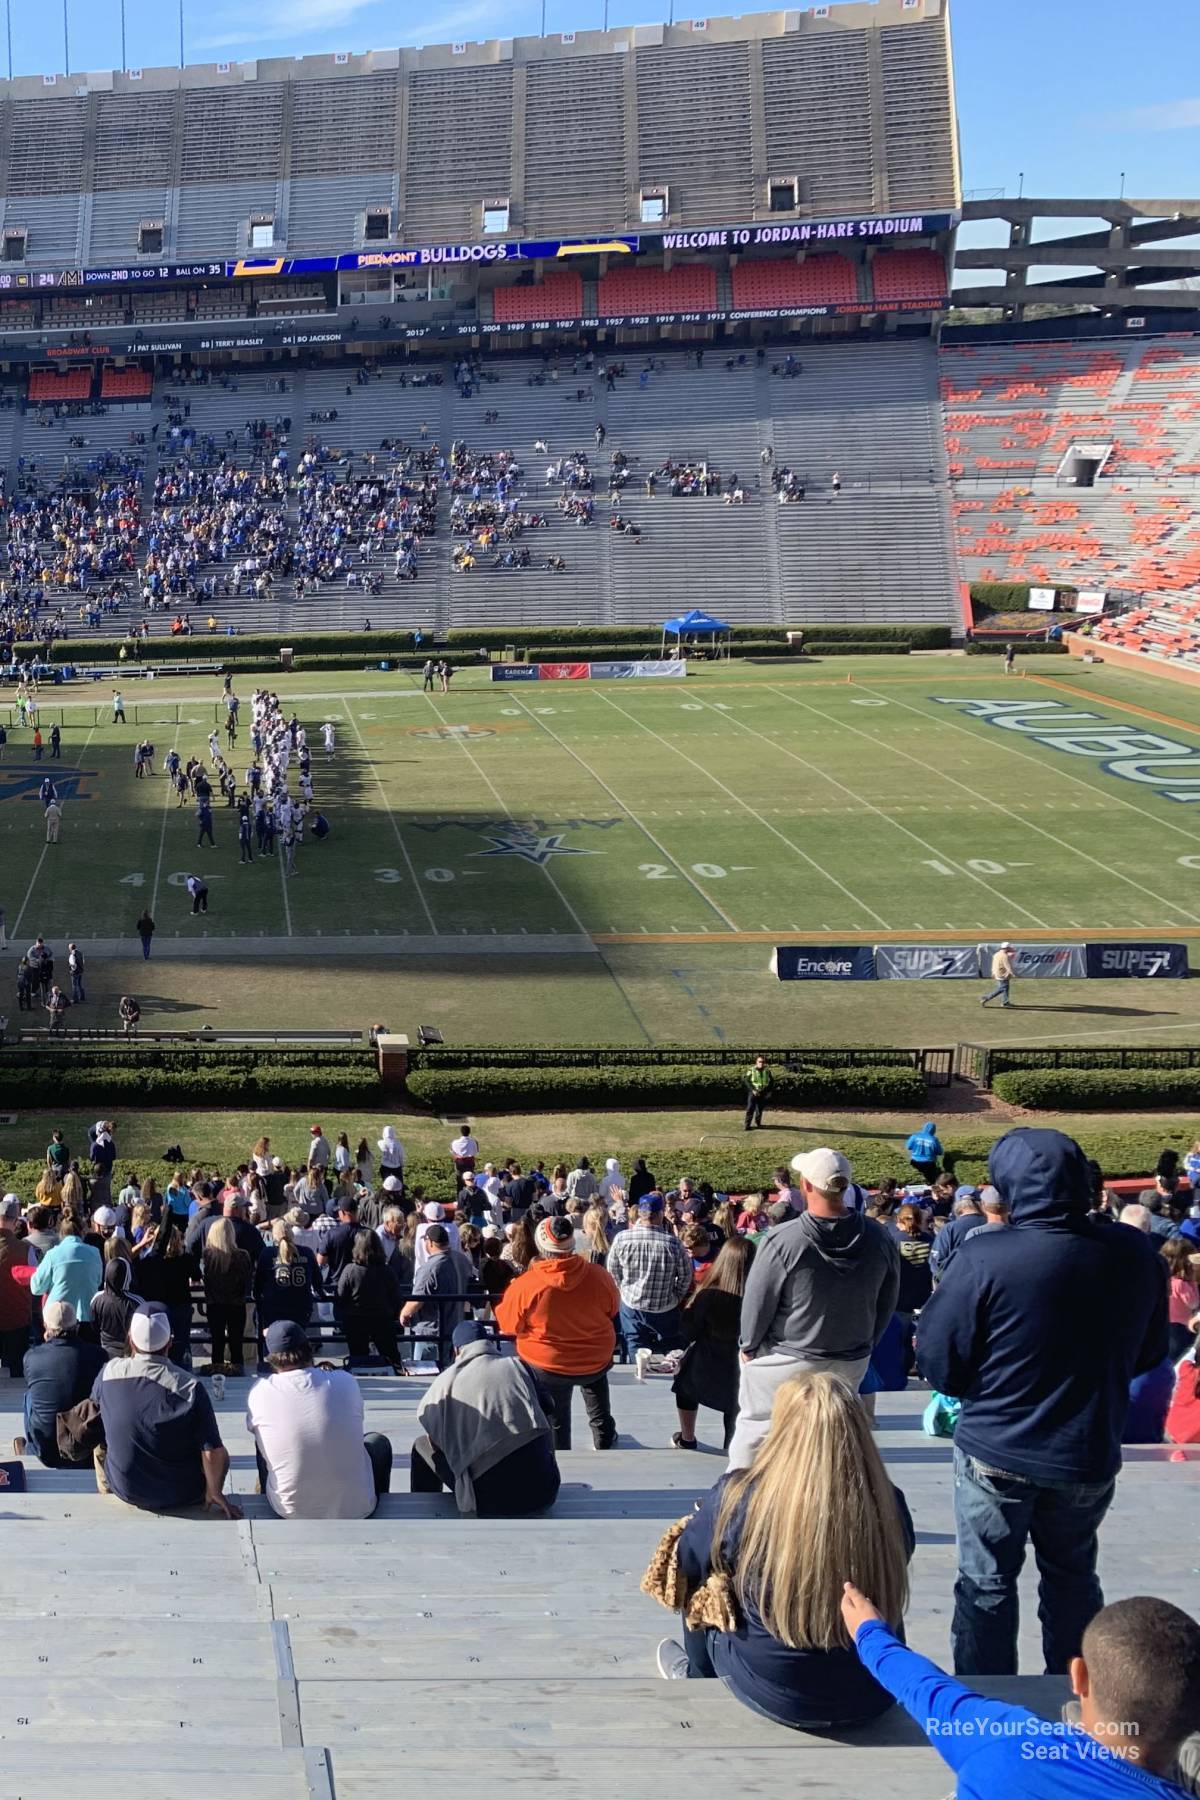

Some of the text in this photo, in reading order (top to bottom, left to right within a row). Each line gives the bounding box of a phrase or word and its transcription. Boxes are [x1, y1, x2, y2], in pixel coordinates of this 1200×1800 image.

[663, 217, 923, 249] WELCOME TO JORDAN-HARE STADIUM
[357, 243, 507, 266] PIEDMONT BULLDOGS
[86, 267, 169, 282] DOWN 2ND TO GO 12
[175, 264, 221, 277] BALL ON 35
[39, 274, 54, 286] 24
[458, 325, 477, 334] 2010
[556, 320, 574, 329] 1987
[681, 313, 700, 322] 1914
[729, 309, 778, 320] CONFERENCE
[779, 306, 828, 317] CHAMPIONS
[215, 339, 235, 348] TERRY
[236, 337, 264, 347] BEASLEY
[309, 333, 341, 343] JACKSON
[137, 343, 150, 352] PAT
[151, 342, 182, 351] SULLIVAN
[373, 867, 456, 884] 30
[638, 863, 729, 880] 20
[921, 859, 1007, 876] 10
[119, 872, 197, 889] 40
[797, 957, 853, 973] Encore
